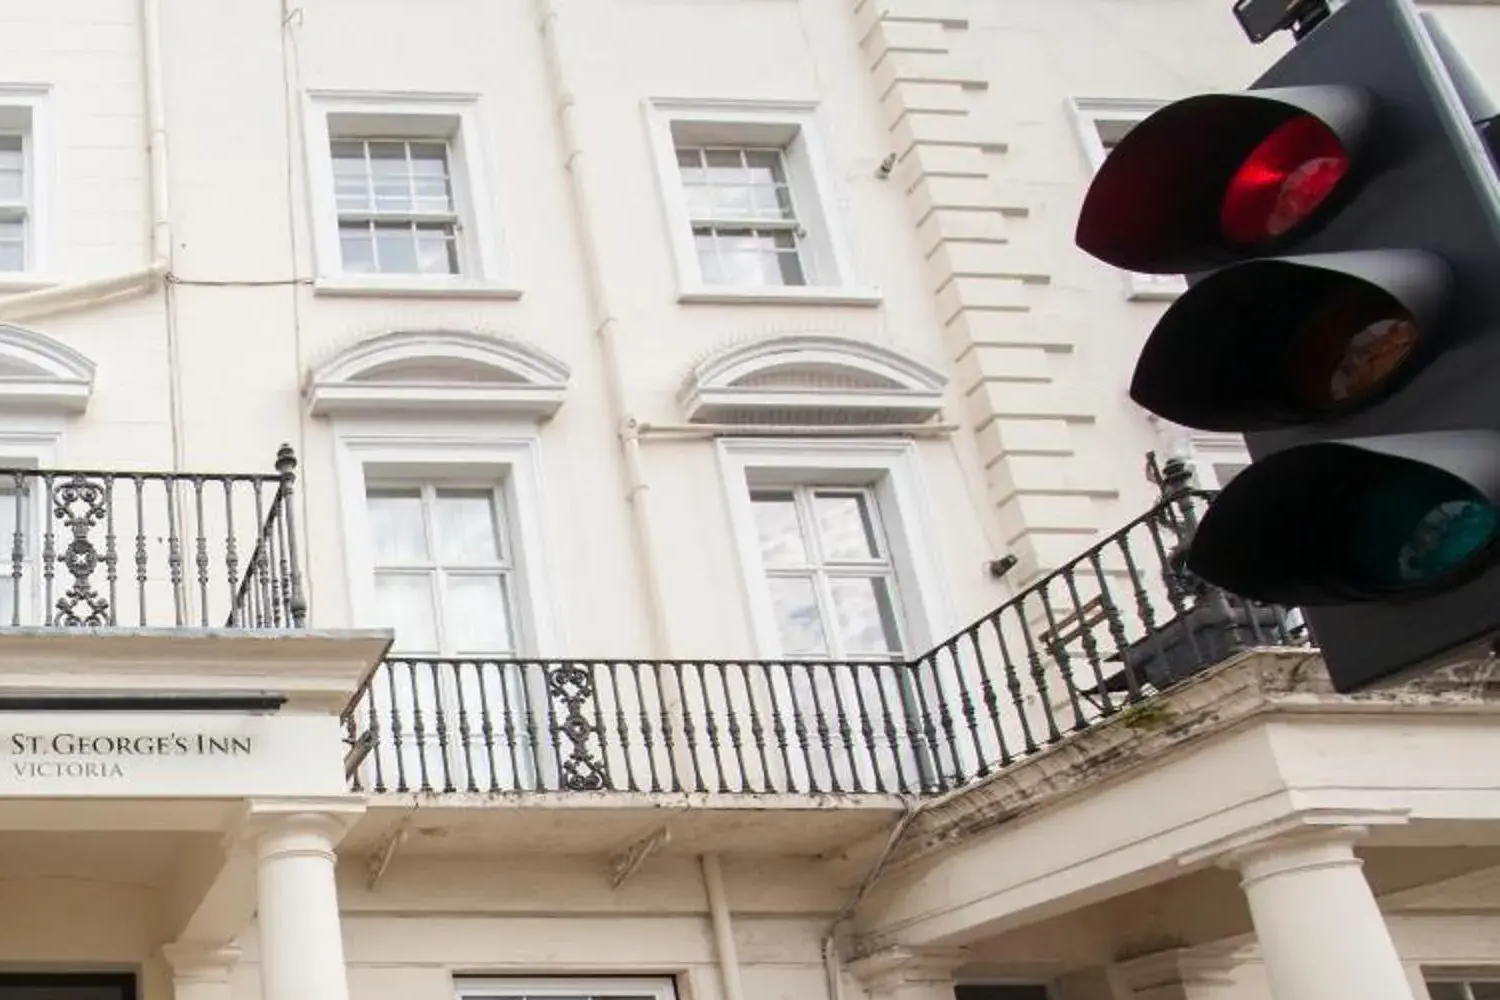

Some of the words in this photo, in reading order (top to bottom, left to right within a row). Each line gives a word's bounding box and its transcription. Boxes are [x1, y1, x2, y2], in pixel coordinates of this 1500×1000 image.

[51, 732, 188, 756] GEORGE'S
[196, 733, 252, 756] INN
[13, 761, 125, 778] VICTORIA
